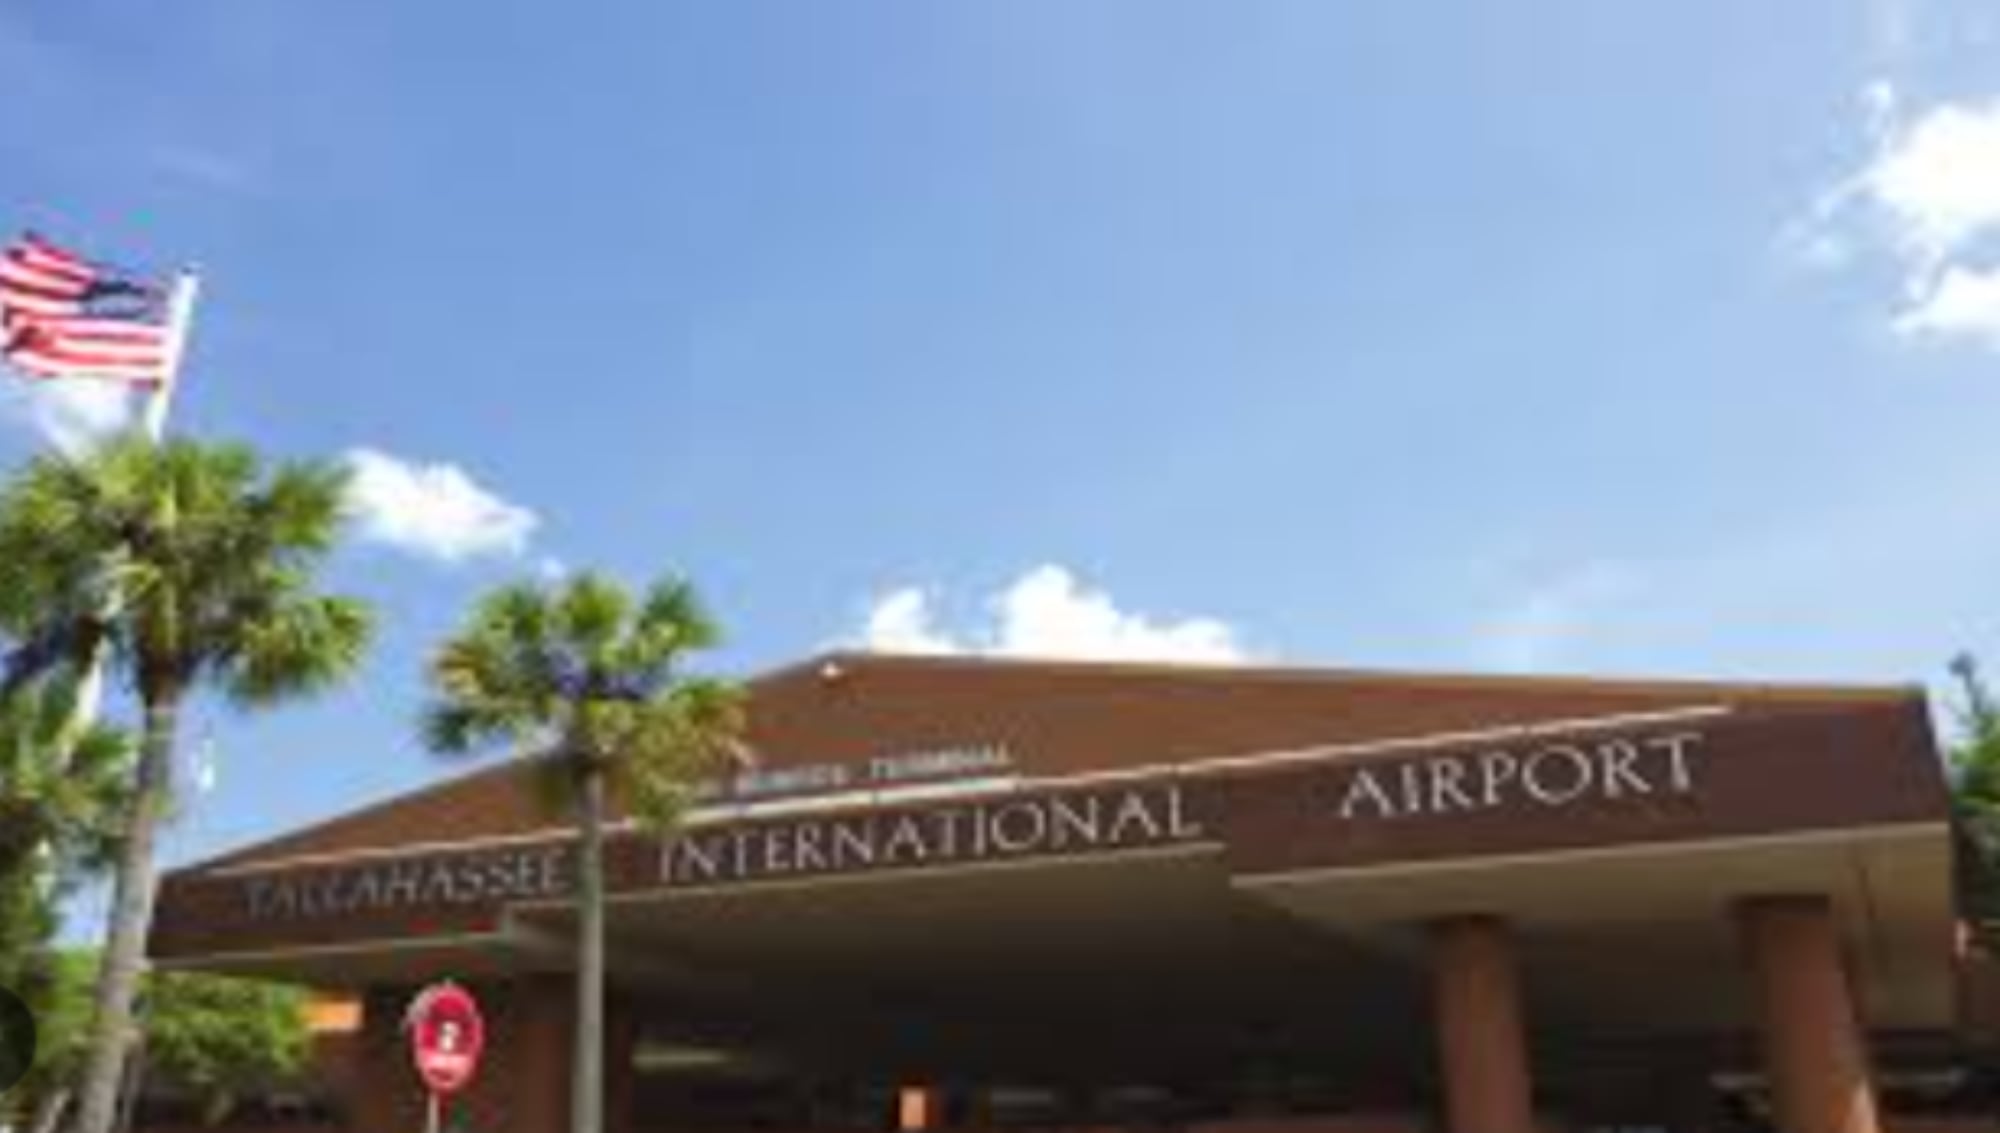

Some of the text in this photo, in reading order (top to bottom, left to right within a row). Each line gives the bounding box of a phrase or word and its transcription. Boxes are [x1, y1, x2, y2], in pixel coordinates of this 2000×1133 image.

[249, 731, 1703, 920] TALLAHASSEE INTERNATIONAL AIRPORT
